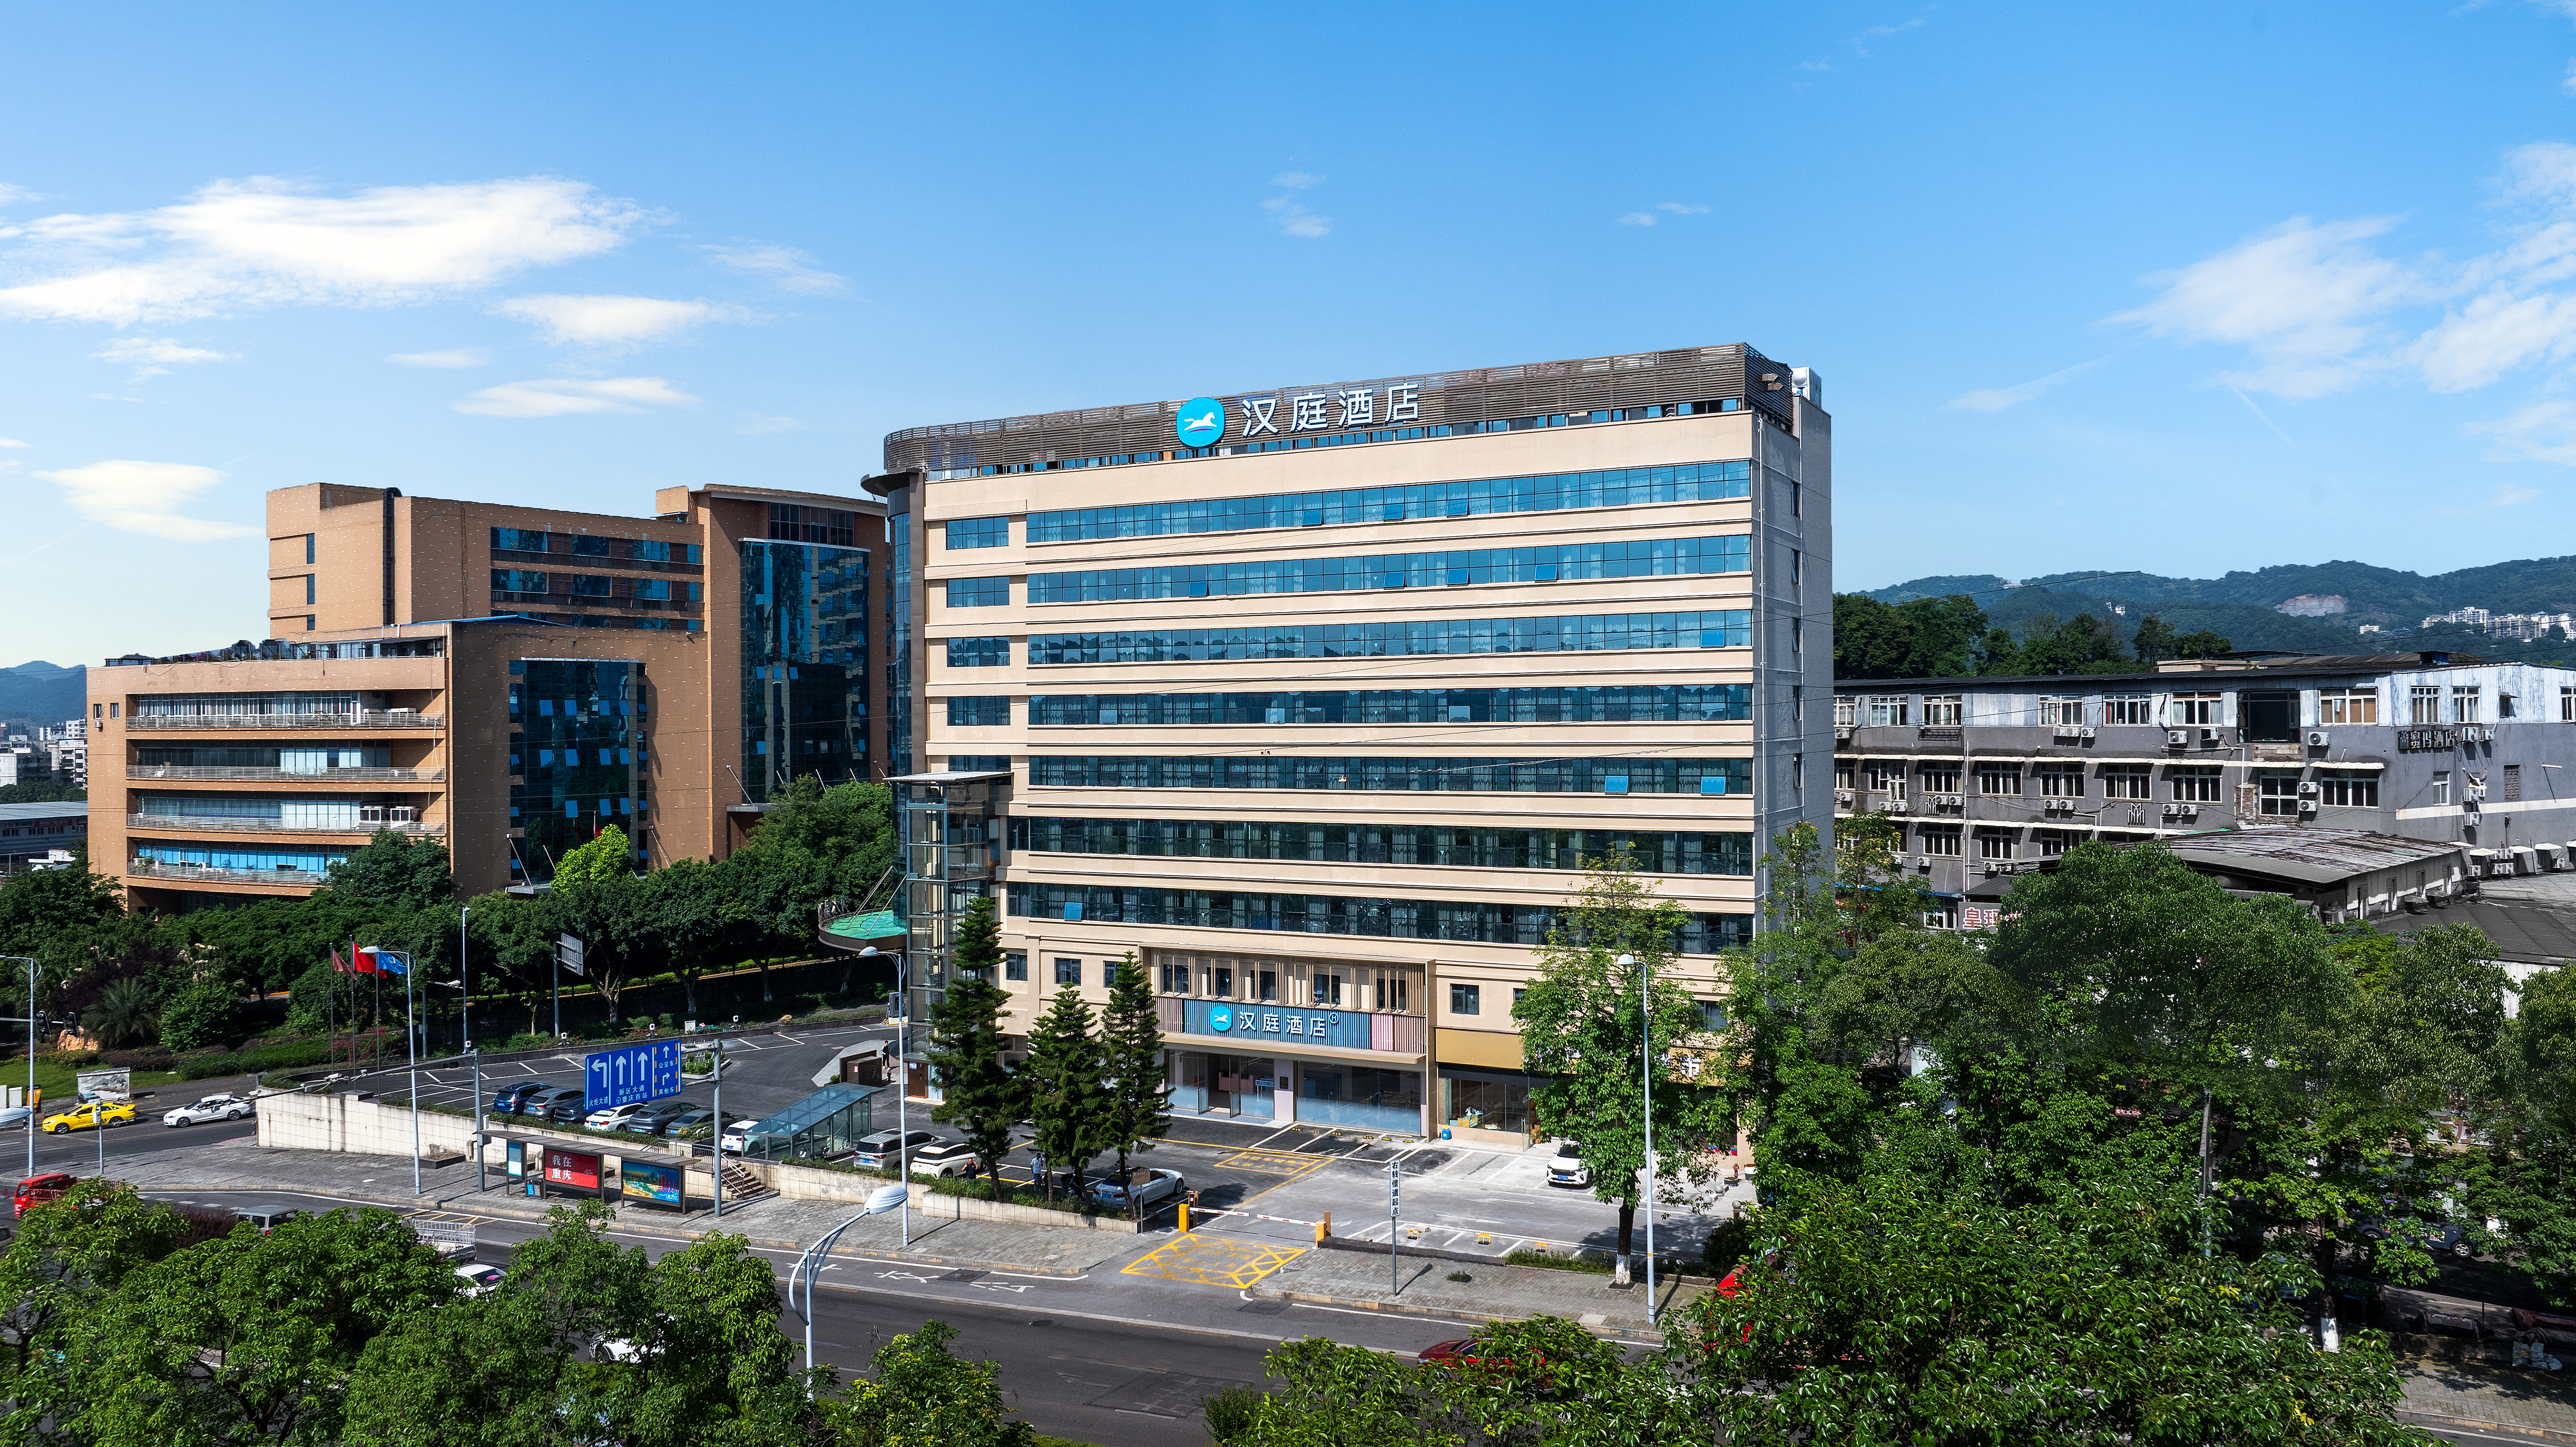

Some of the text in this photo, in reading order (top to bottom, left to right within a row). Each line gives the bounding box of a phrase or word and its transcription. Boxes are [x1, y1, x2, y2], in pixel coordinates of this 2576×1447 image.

[1242, 383, 1419, 437] 汉庭酒店
[1239, 1011, 1326, 1037] 汉庭酒店
[658, 1060, 675, 1069] 公交车
[619, 1084, 645, 1095] 新区大道
[658, 1087, 675, 1096] 其他车
[589, 1096, 608, 1106] 火炬大道
[622, 1092, 648, 1103] 重庆西站
[552, 1155, 572, 1167] 我在
[552, 1168, 572, 1180] 重庆
